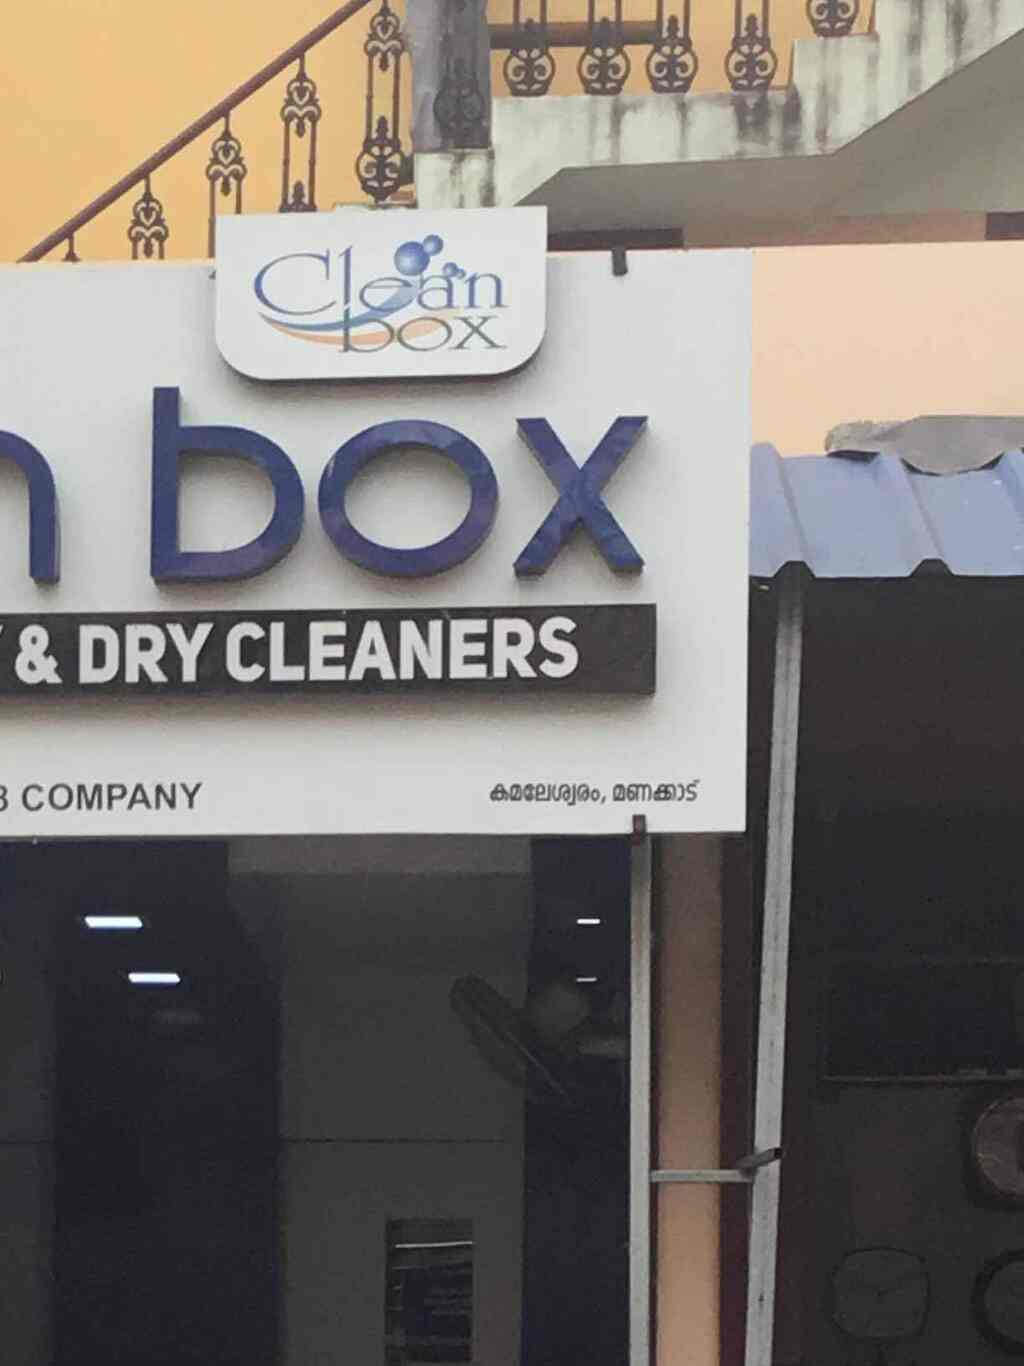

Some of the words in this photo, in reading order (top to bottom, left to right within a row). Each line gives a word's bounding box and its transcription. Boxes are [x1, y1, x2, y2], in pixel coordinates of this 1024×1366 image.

[254, 245, 509, 316] Clean
[339, 306, 508, 352] box
[150, 386, 650, 586] box
[13, 623, 63, 685] &
[78, 621, 212, 683] DRY
[224, 616, 579, 682] CLEANERS
[21, 782, 202, 812] COMPANY
